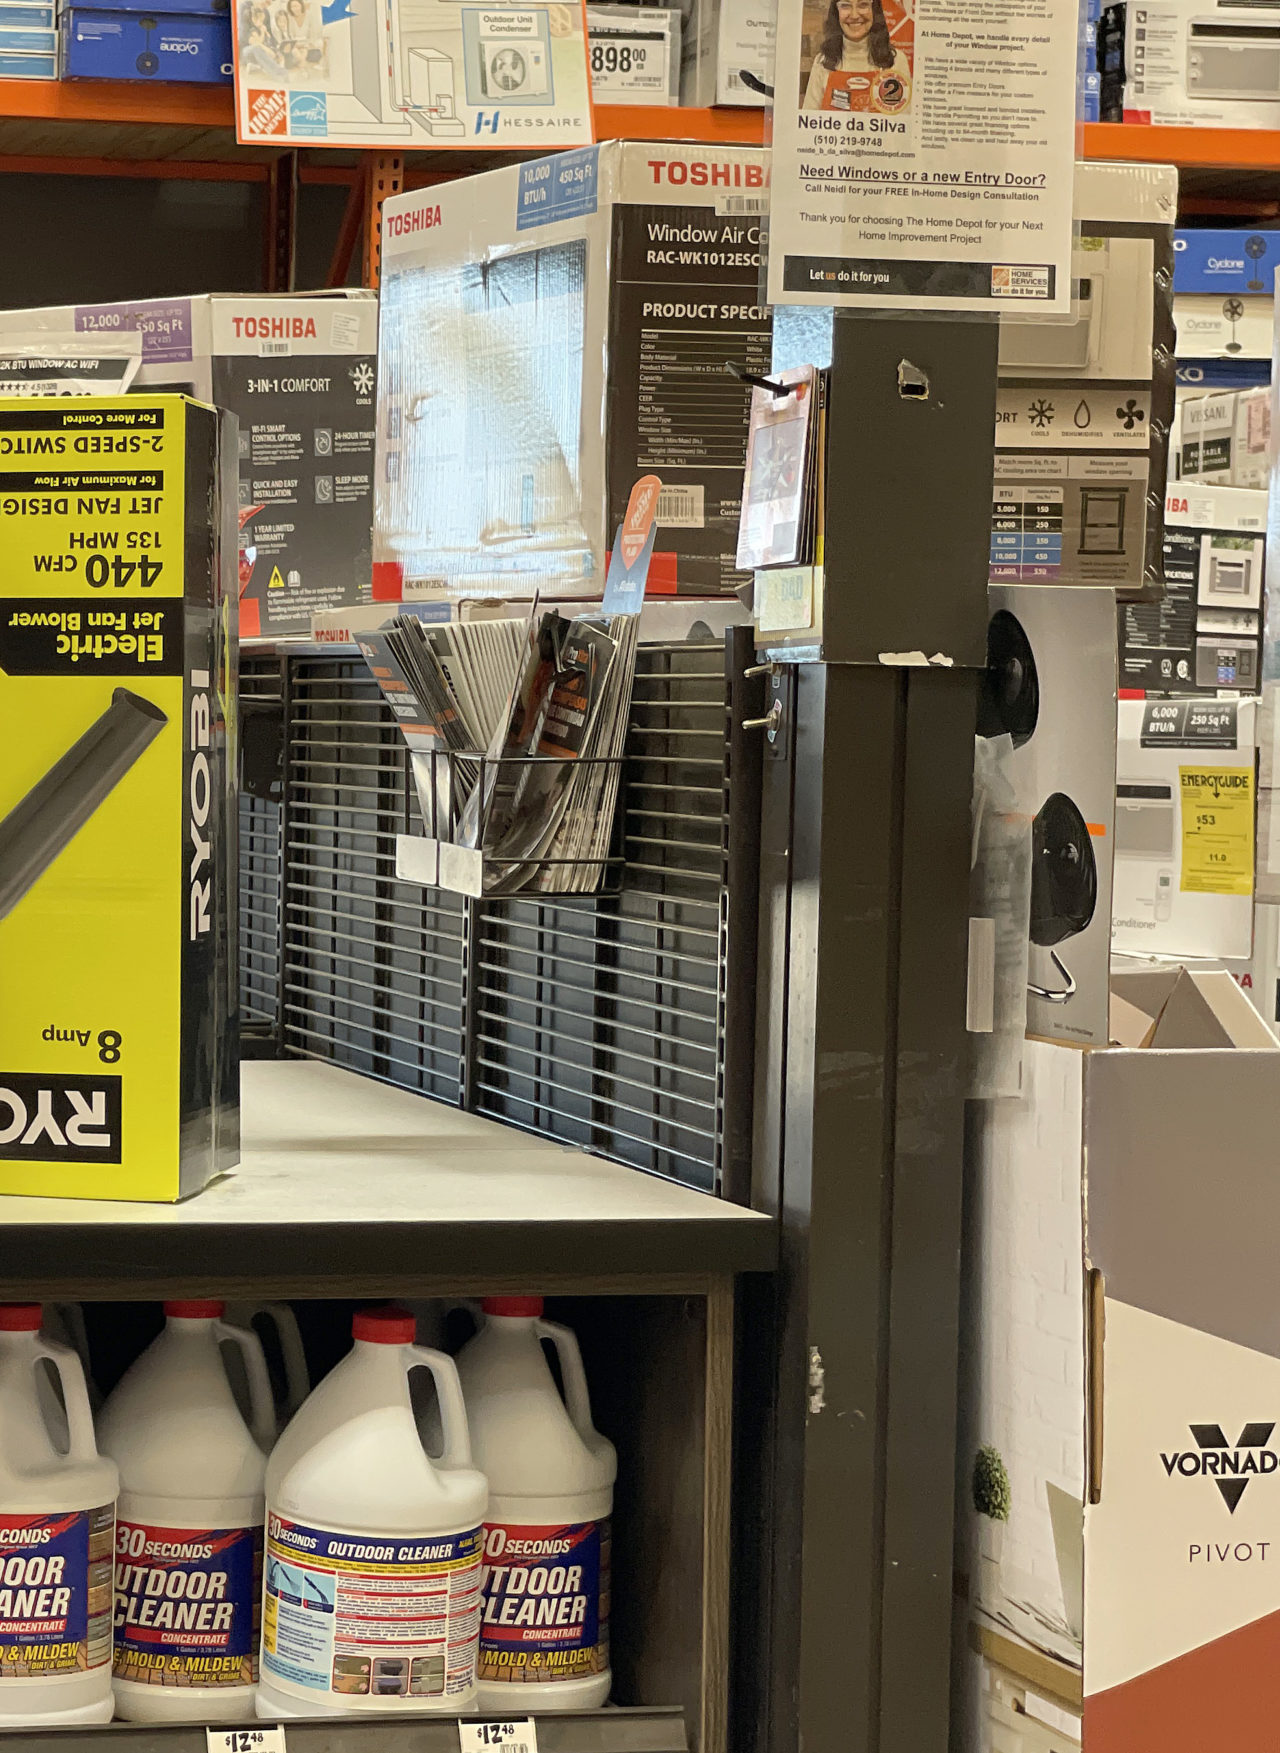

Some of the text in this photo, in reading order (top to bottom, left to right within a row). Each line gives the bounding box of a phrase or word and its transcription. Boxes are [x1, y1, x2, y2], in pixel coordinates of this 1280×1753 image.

[483, 16, 532, 24] Outdoor Unit
[489, 25, 532, 33] Condenser
[160, 42, 198, 54] Cyclone
[503, 117, 582, 127] HESSAIRE
[798, 115, 840, 129] Neide
[846, 118, 864, 131] da
[869, 119, 905, 133] Silva
[814, 136, 882, 146] (510) 219-9748
[524, 164, 550, 184] 10,000
[559, 164, 592, 183] 450 Sq Ft
[800, 164, 1046, 186] Need Windows or a new Entry Door?
[524, 187, 546, 205] BTU/h
[805, 184, 821, 192] Call
[848, 186, 860, 194] for
[863, 188, 882, 196] your
[885, 187, 909, 196] FREE
[912, 188, 948, 198] In-Home
[950, 190, 980, 200] Design
[984, 191, 1039, 200] Consultation
[387, 205, 442, 238] TOSHIBA
[800, 212, 1043, 230] Thank you for choosing The Home Depot for your Next
[647, 224, 744, 244] Window Air
[859, 231, 981, 245] Home Improvement Project
[1208, 258, 1244, 270] Cyclone
[810, 268, 890, 284] Let us do it for you
[643, 303, 717, 319] PRODUCT
[82, 313, 120, 329] 12,000
[135, 319, 183, 333] 550 Sq Ft
[232, 317, 317, 338] TOSHIBA
[12, 360, 28, 369] BTU
[29, 359, 64, 369] WINDOW
[65, 360, 78, 368] AC
[80, 359, 99, 369] WIFI
[247, 378, 331, 393] 3-IN-1 COMFORT
[62, 414, 156, 425] For More Control
[72, 435, 164, 453] 2-SPEED
[252, 433, 301, 442] CONTROL OPTIONS
[34, 475, 156, 488] for Maximum Air Flow
[253, 480, 298, 489] QUICK AND EASY
[352, 475, 368, 483] MODE
[253, 489, 292, 497] INSTALLATION
[76, 497, 122, 515] FAN
[127, 496, 163, 514] JET
[69, 531, 162, 549] 135 MPH
[33, 553, 164, 588] 440 CFM
[8, 612, 164, 630] Jet Fan Blower
[55, 633, 164, 662] Electric
[1152, 707, 1178, 718] 6,000
[1149, 722, 1175, 733] BTU/h
[1191, 715, 1229, 727] 250 Sq Ft
[1181, 775, 1248, 788] ENERGYGUIDE
[190, 668, 210, 941] RYOBI
[41, 1024, 122, 1064] 8 Amp
[1160, 1451, 1280, 1477] VORNAD
[116, 1526, 213, 1559] 30 SECONDS
[280, 1530, 317, 1549] SECONDS
[327, 1541, 394, 1560] OUTDOOR
[398, 1544, 453, 1561] CLEANER
[505, 1539, 571, 1554] SECONDS
[1189, 1542, 1270, 1562] PIVOT
[114, 1563, 227, 1599] UTDOOR
[0, 1620, 65, 1632] CONCENTRATE
[523, 1627, 582, 1639] CONCENTRATE
[161, 1632, 227, 1644] CONCENTRATE
[8, 1645, 19, 1661] &
[23, 1642, 79, 1661] MILDEW
[126, 1650, 243, 1671] MOLD & MILDEW
